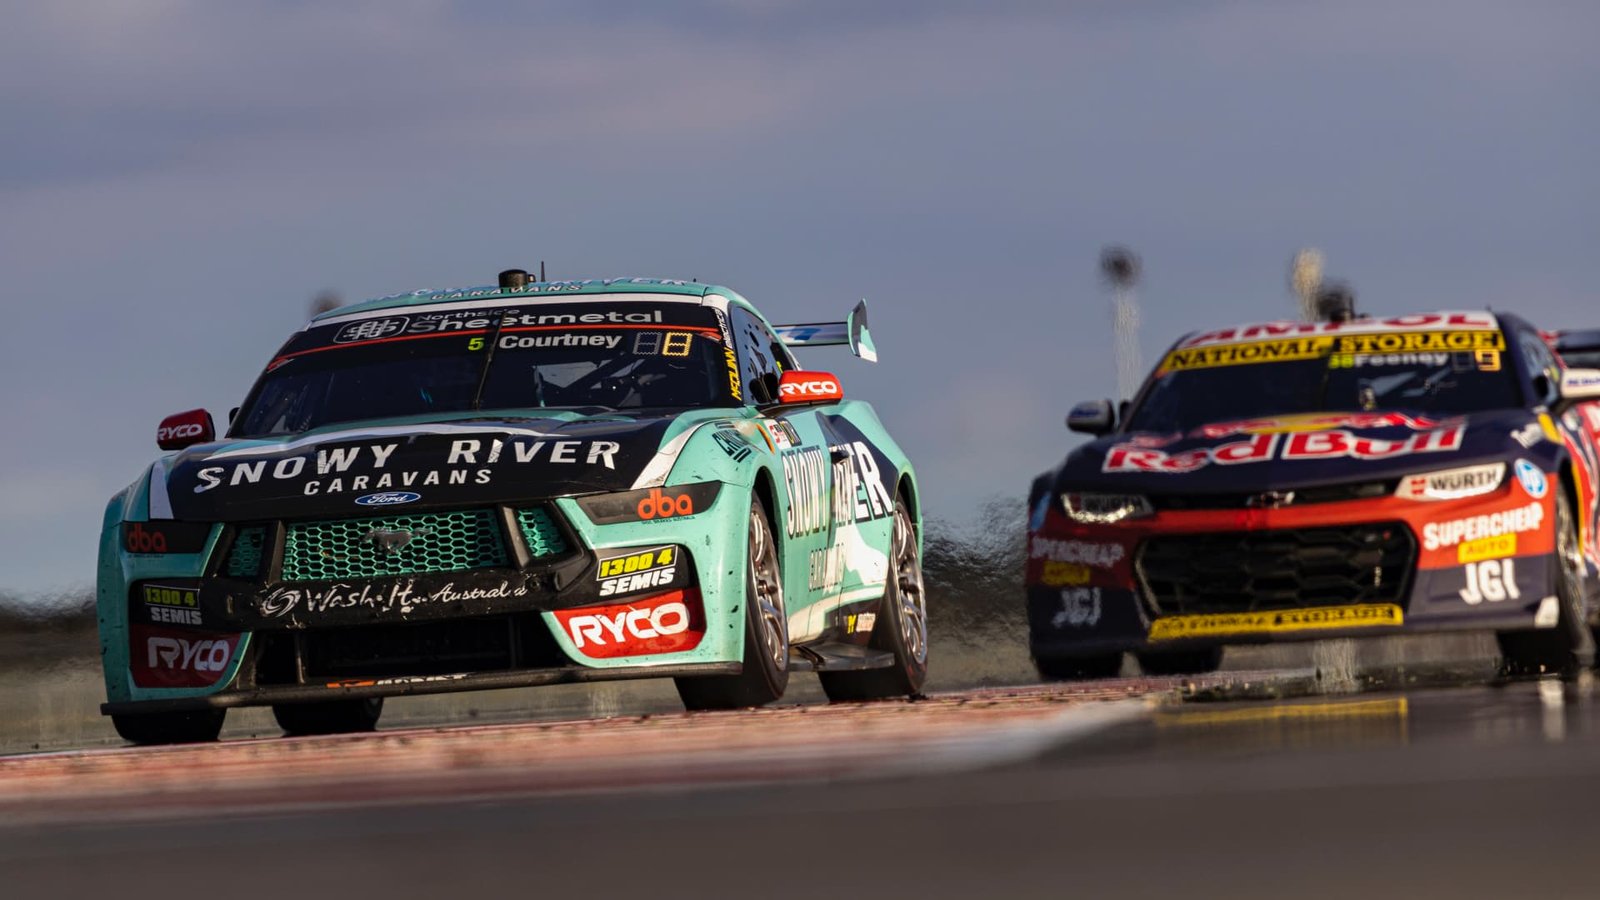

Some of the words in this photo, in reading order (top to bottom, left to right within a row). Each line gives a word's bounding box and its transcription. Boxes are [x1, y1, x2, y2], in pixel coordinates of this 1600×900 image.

[408, 310, 662, 333] Sheetmetal
[468, 337, 485, 351] 5
[499, 333, 622, 349] Courtney
[1170, 338, 1324, 368] NATIONAL
[1338, 330, 1497, 353] STORAGE
[1354, 353, 1448, 367] Feeney
[780, 381, 838, 396] RYCO
[157, 424, 202, 440] RYCO
[1101, 432, 1275, 472] Red
[1281, 416, 1468, 459] Bull
[194, 444, 398, 493] SNOWY
[447, 439, 620, 469] RIVER
[304, 469, 492, 495] CARAVANS
[367, 493, 409, 505] Ford
[638, 487, 692, 519] dba
[600, 553, 653, 577] 1300
[657, 549, 673, 565] 4
[432, 581, 528, 602] Australa
[600, 568, 675, 596] SEMIS
[144, 588, 177, 605] 1300
[184, 591, 195, 606] 4
[151, 607, 202, 624] SEMIS
[568, 602, 690, 648] RYCO
[147, 637, 230, 671] RYCO
